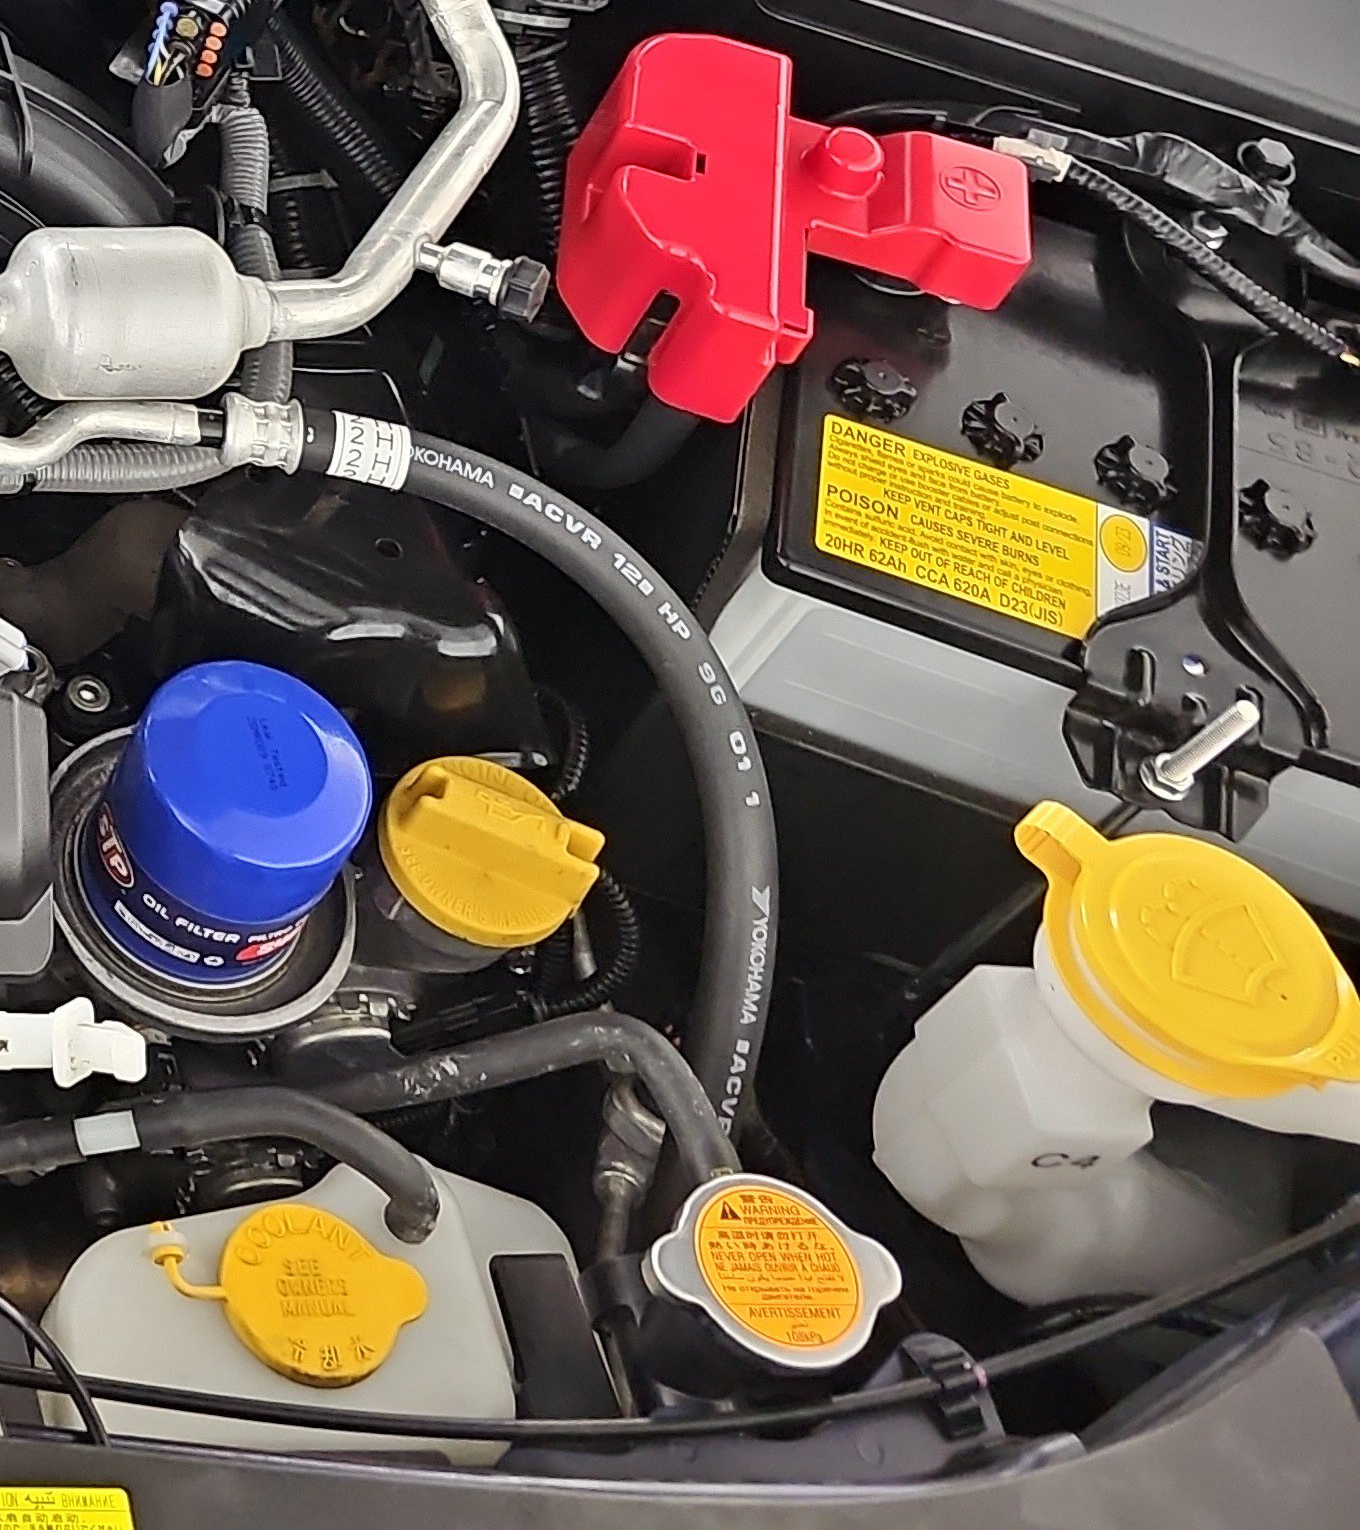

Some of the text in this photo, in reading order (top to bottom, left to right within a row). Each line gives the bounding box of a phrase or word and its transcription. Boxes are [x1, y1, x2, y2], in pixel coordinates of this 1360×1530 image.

[831, 421, 1010, 490] DANGER EXPLOSIVE GASES
[827, 483, 1040, 567] POISON CAUSES SEVERE BURNS
[883, 488, 1070, 561] KEEP VENT CAPS TIGHT AND LEVEL
[879, 536, 908, 554] KEEP
[911, 547, 933, 564] OUT
[935, 556, 951, 568] OF
[953, 562, 991, 584] REACH
[994, 576, 1009, 589] OF
[1011, 582, 1066, 610] CHILDREN
[1156, 530, 1170, 575] START
[825, 533, 1063, 626] 20HR 62Ah CCA 620A D23(JIS)
[658, 601, 692, 640] HP
[99, 814, 128, 877] STP
[142, 893, 169, 920] OIL
[175, 916, 241, 944] FILTER
[739, 916, 770, 1025] YOKOHAMA
[740, 1205, 801, 1216] WARNING
[235, 1211, 372, 1266] COOLANT
[710, 1251, 837, 1262] NEVER OPEN WHEN HOT
[276, 1279, 348, 1296] OWNERS
[283, 1258, 321, 1277] SEE
[714, 1262, 726, 1272] NE
[730, 1262, 762, 1272] JAMAIS
[764, 1262, 799, 1273] OUVRIR
[810, 1262, 840, 1273] CHAUD
[280, 1300, 356, 1317] MANUAL
[749, 1306, 841, 1318] AVERTISSEMENT
[61, 1493, 117, 1508] ВНИМАНИЕ
